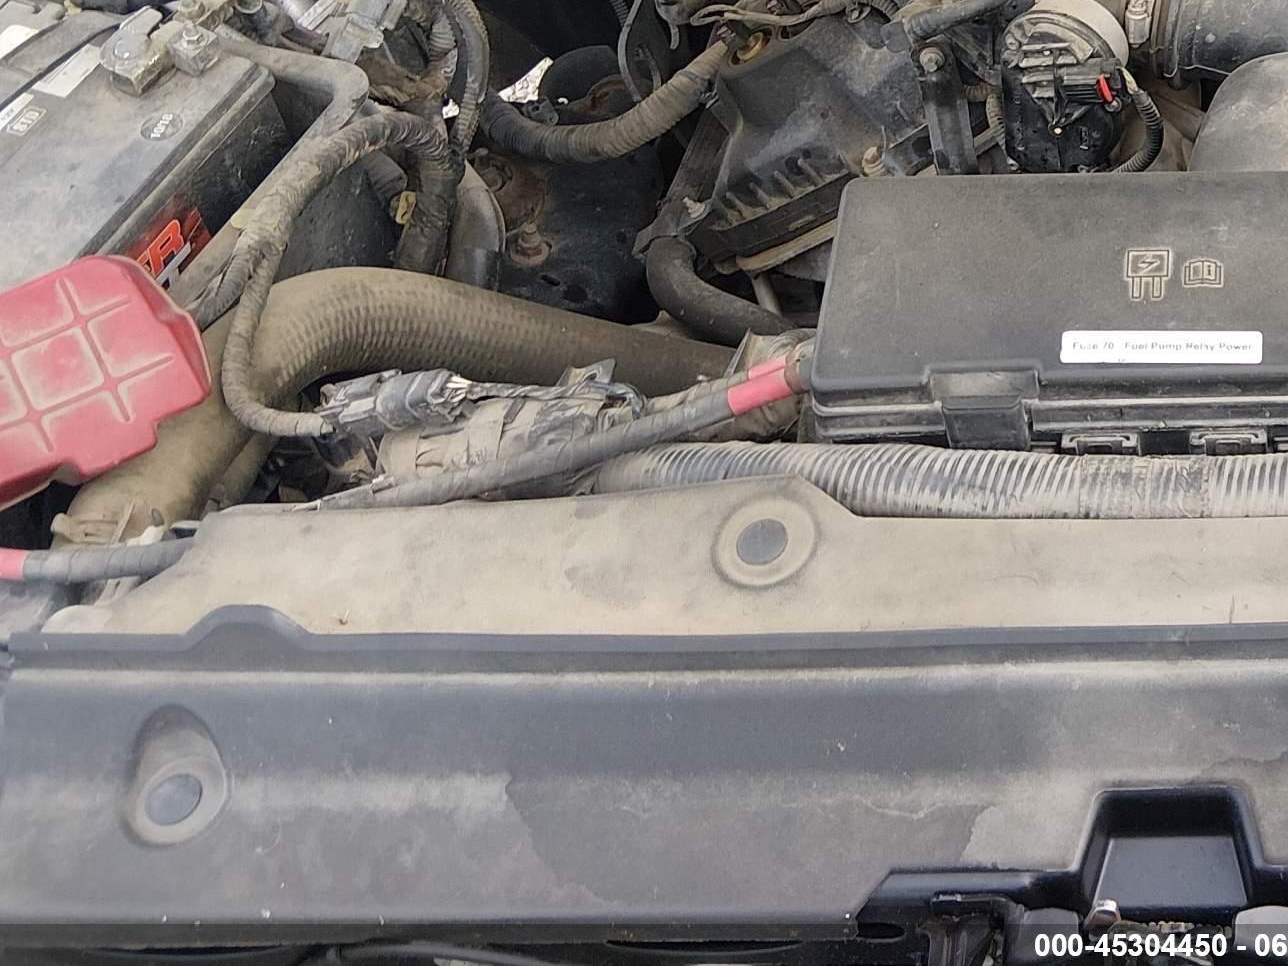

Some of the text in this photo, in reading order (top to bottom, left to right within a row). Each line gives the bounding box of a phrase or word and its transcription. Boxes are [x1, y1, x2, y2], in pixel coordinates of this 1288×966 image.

[1124, 341, 1148, 350] Fuel
[1150, 341, 1181, 351] Pump
[1219, 341, 1252, 351] Power
